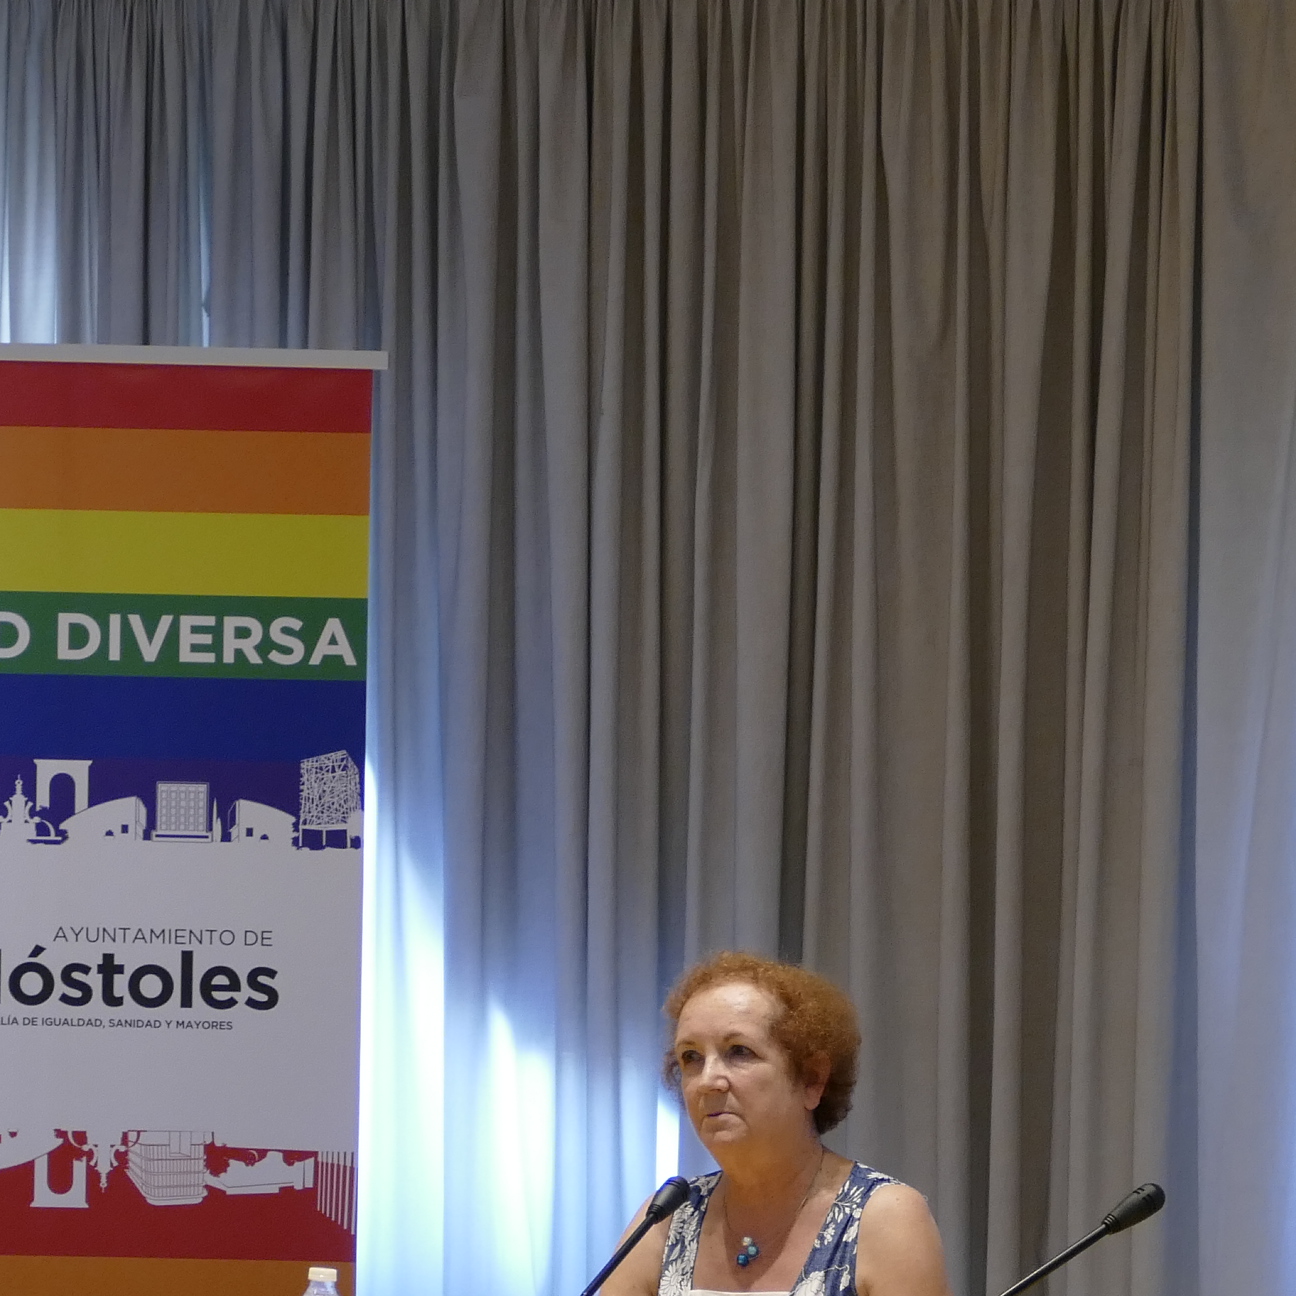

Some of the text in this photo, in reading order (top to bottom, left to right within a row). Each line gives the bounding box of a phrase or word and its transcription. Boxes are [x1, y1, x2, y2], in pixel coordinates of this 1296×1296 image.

[57, 612, 357, 666] DIVERSA
[53, 926, 273, 947] AYUNTAMIENTO DE
[22, 1017, 38, 1026] DE
[41, 1017, 106, 1029] IGUALDAD,
[108, 1018, 162, 1029] SANIDAD
[165, 1020, 174, 1029] Y
[175, 1020, 234, 1031] MAYORES
